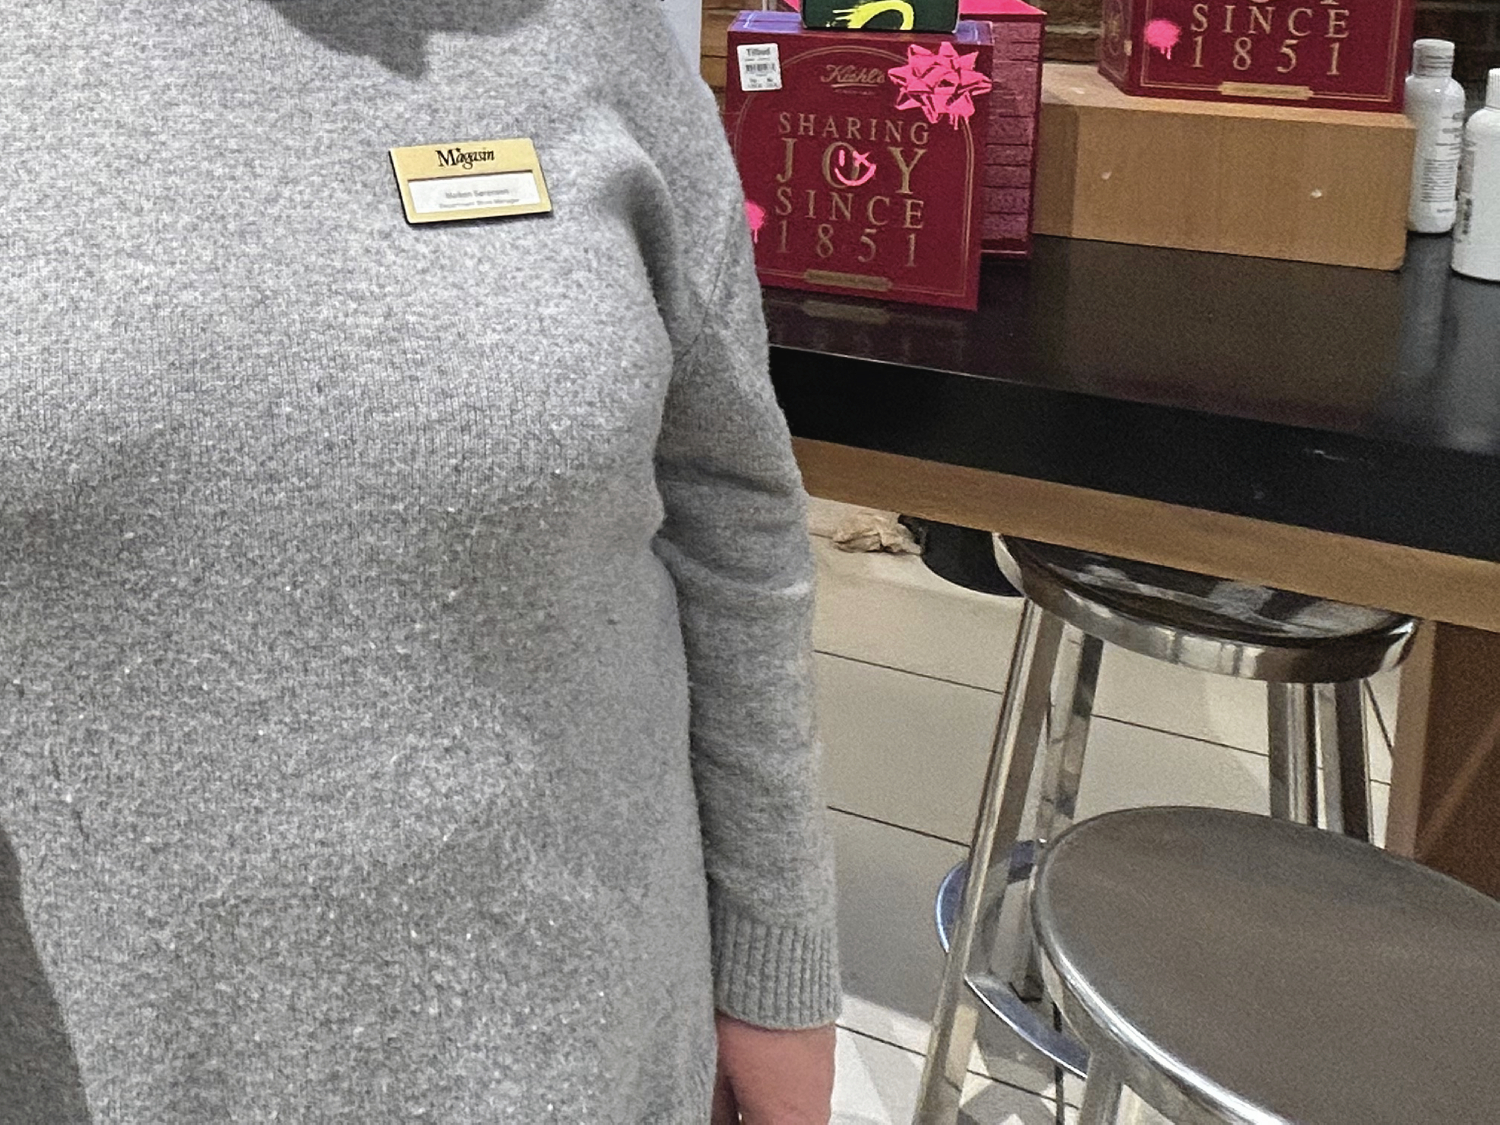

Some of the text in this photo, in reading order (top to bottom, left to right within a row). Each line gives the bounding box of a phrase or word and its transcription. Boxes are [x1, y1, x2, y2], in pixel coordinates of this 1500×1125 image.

[1191, 5, 1350, 39] SINCE
[820, 64, 886, 84] Kiehl's
[1192, 36, 1342, 76] 1851
[779, 111, 931, 145] SHARING
[435, 147, 495, 170] Magasin
[776, 137, 927, 195] JOY
[775, 188, 925, 230] SINCE
[776, 220, 919, 268] 1851
